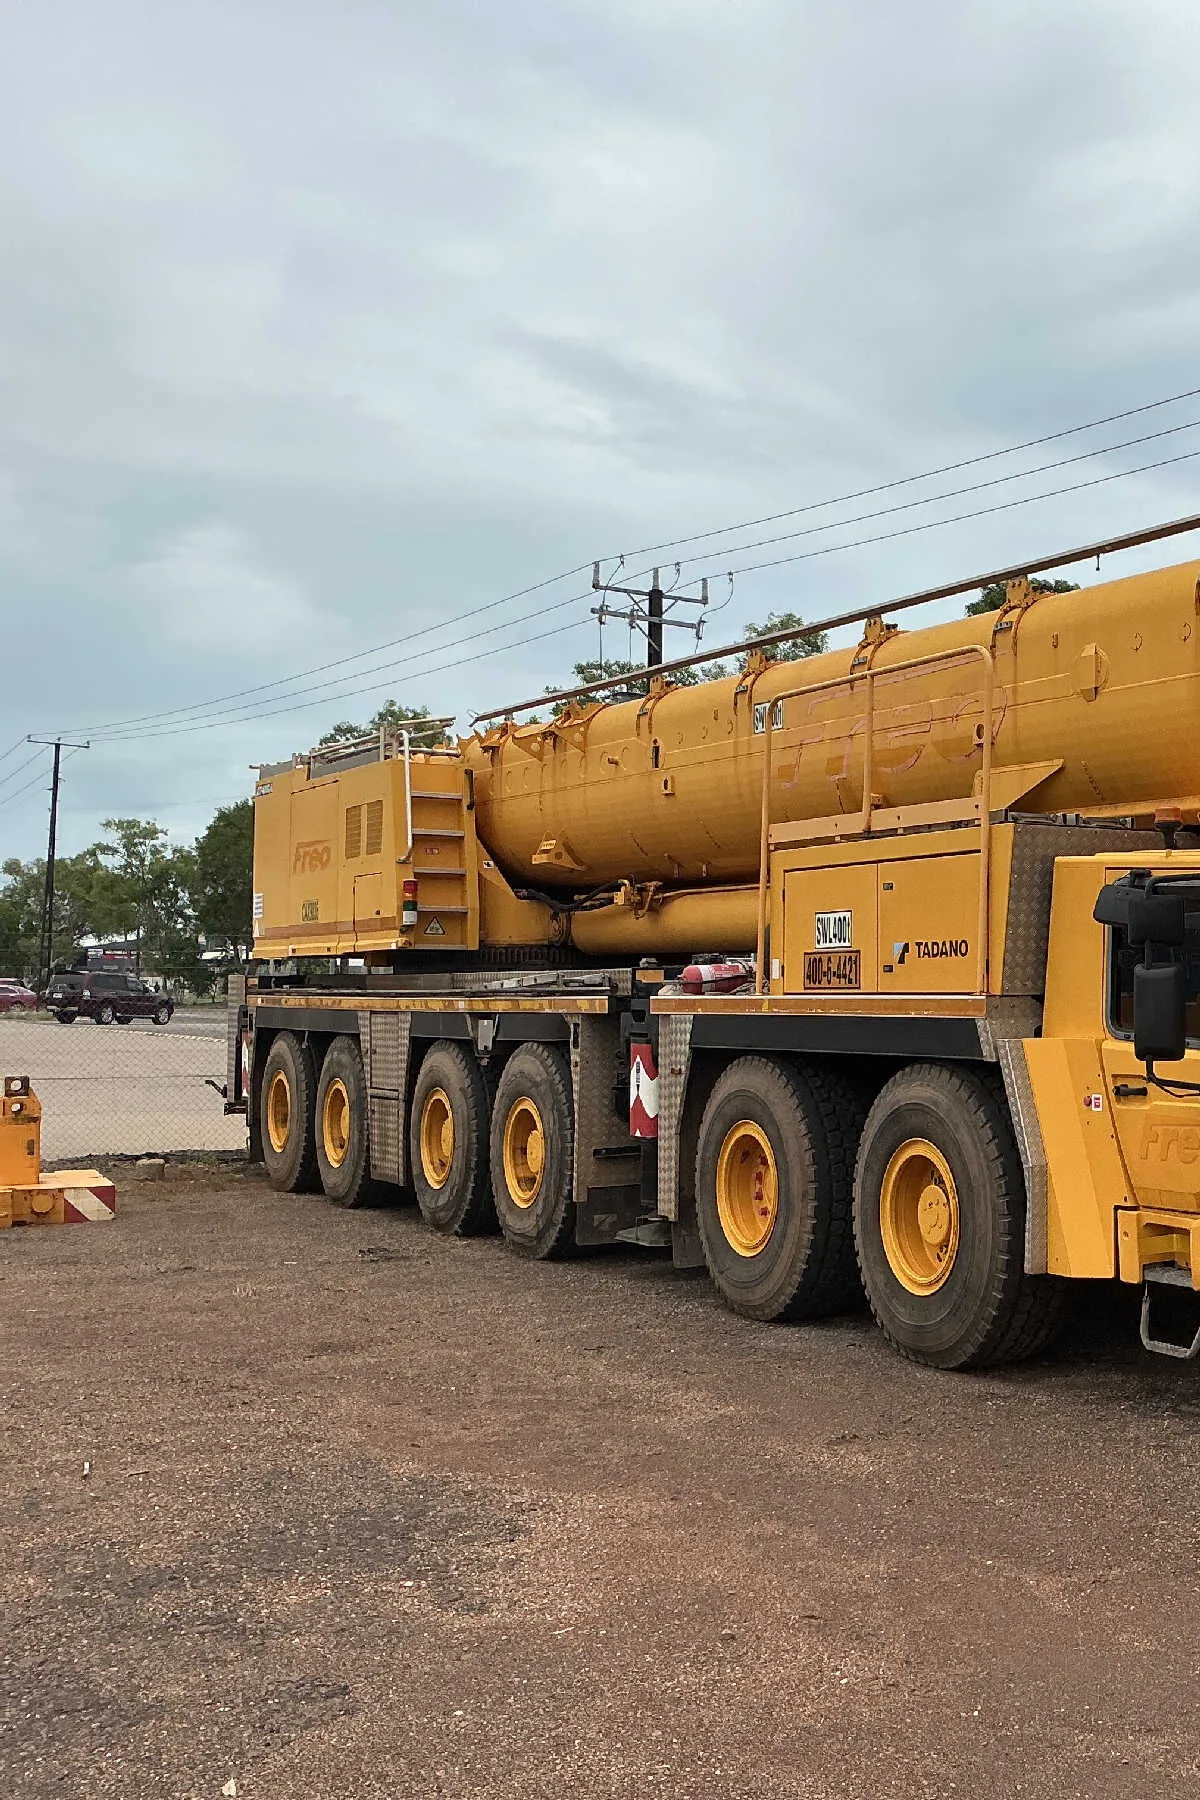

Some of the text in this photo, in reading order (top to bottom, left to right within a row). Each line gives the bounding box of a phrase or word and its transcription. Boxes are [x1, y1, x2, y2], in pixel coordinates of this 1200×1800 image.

[816, 915, 850, 946] SWL400t
[915, 939, 969, 959] TADANO
[805, 955, 858, 985] 400-6-4421
